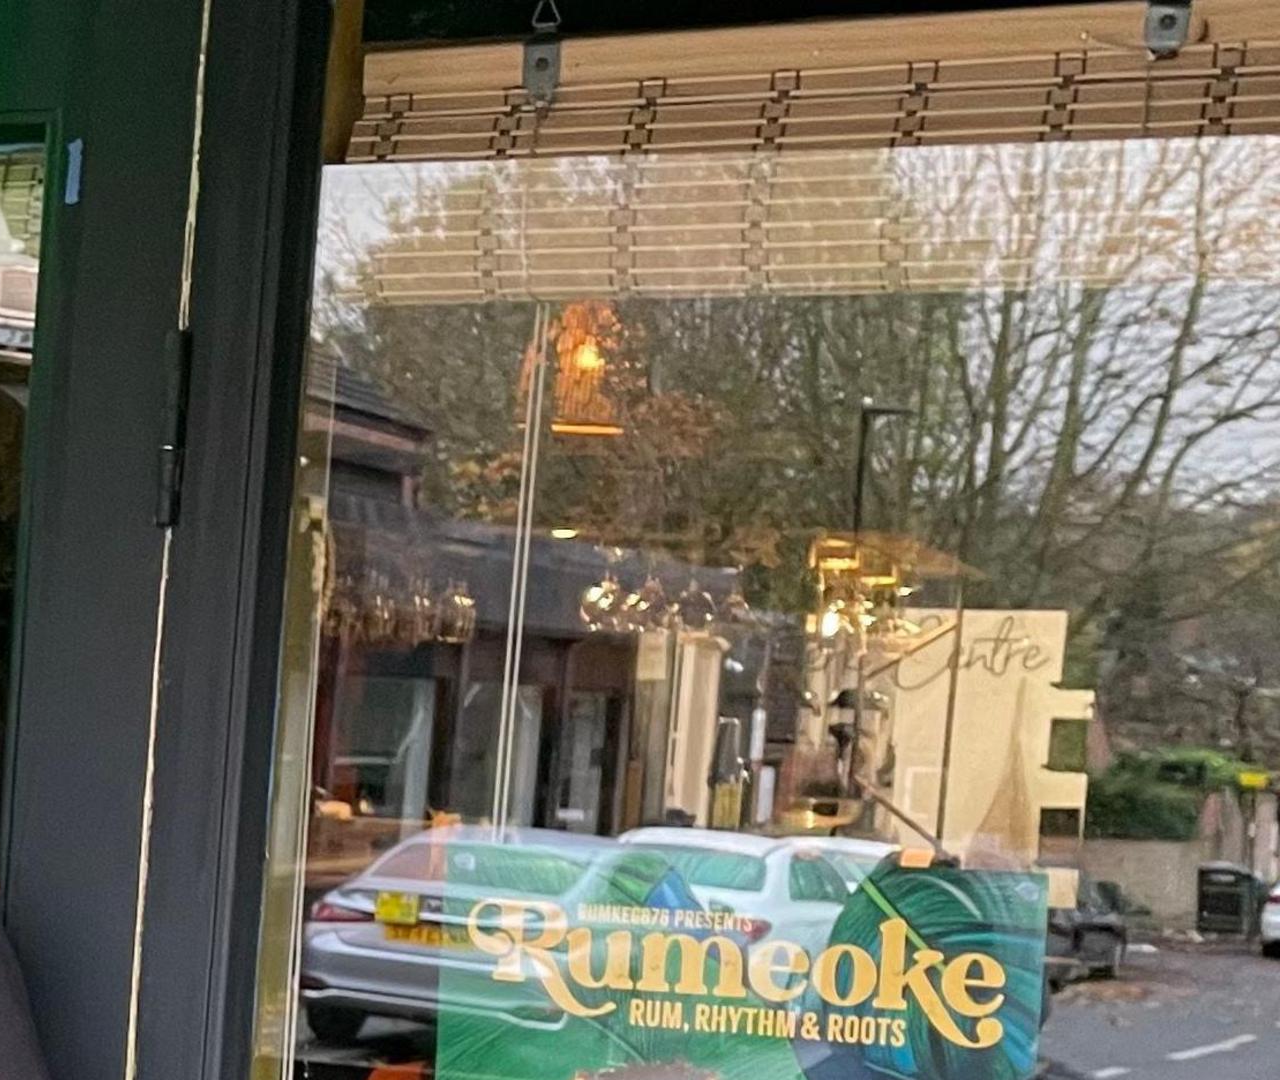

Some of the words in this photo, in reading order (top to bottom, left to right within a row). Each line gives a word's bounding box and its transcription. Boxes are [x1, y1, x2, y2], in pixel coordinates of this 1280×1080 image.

[896, 615, 1050, 690] Centre
[674, 909, 752, 931] PRESENTS
[468, 899, 1005, 1049] Rumeoke
[629, 999, 689, 1034] RUM,
[695, 1002, 795, 1039] RHYTHM
[802, 1011, 820, 1041] &
[828, 1014, 905, 1046] ROOTS
